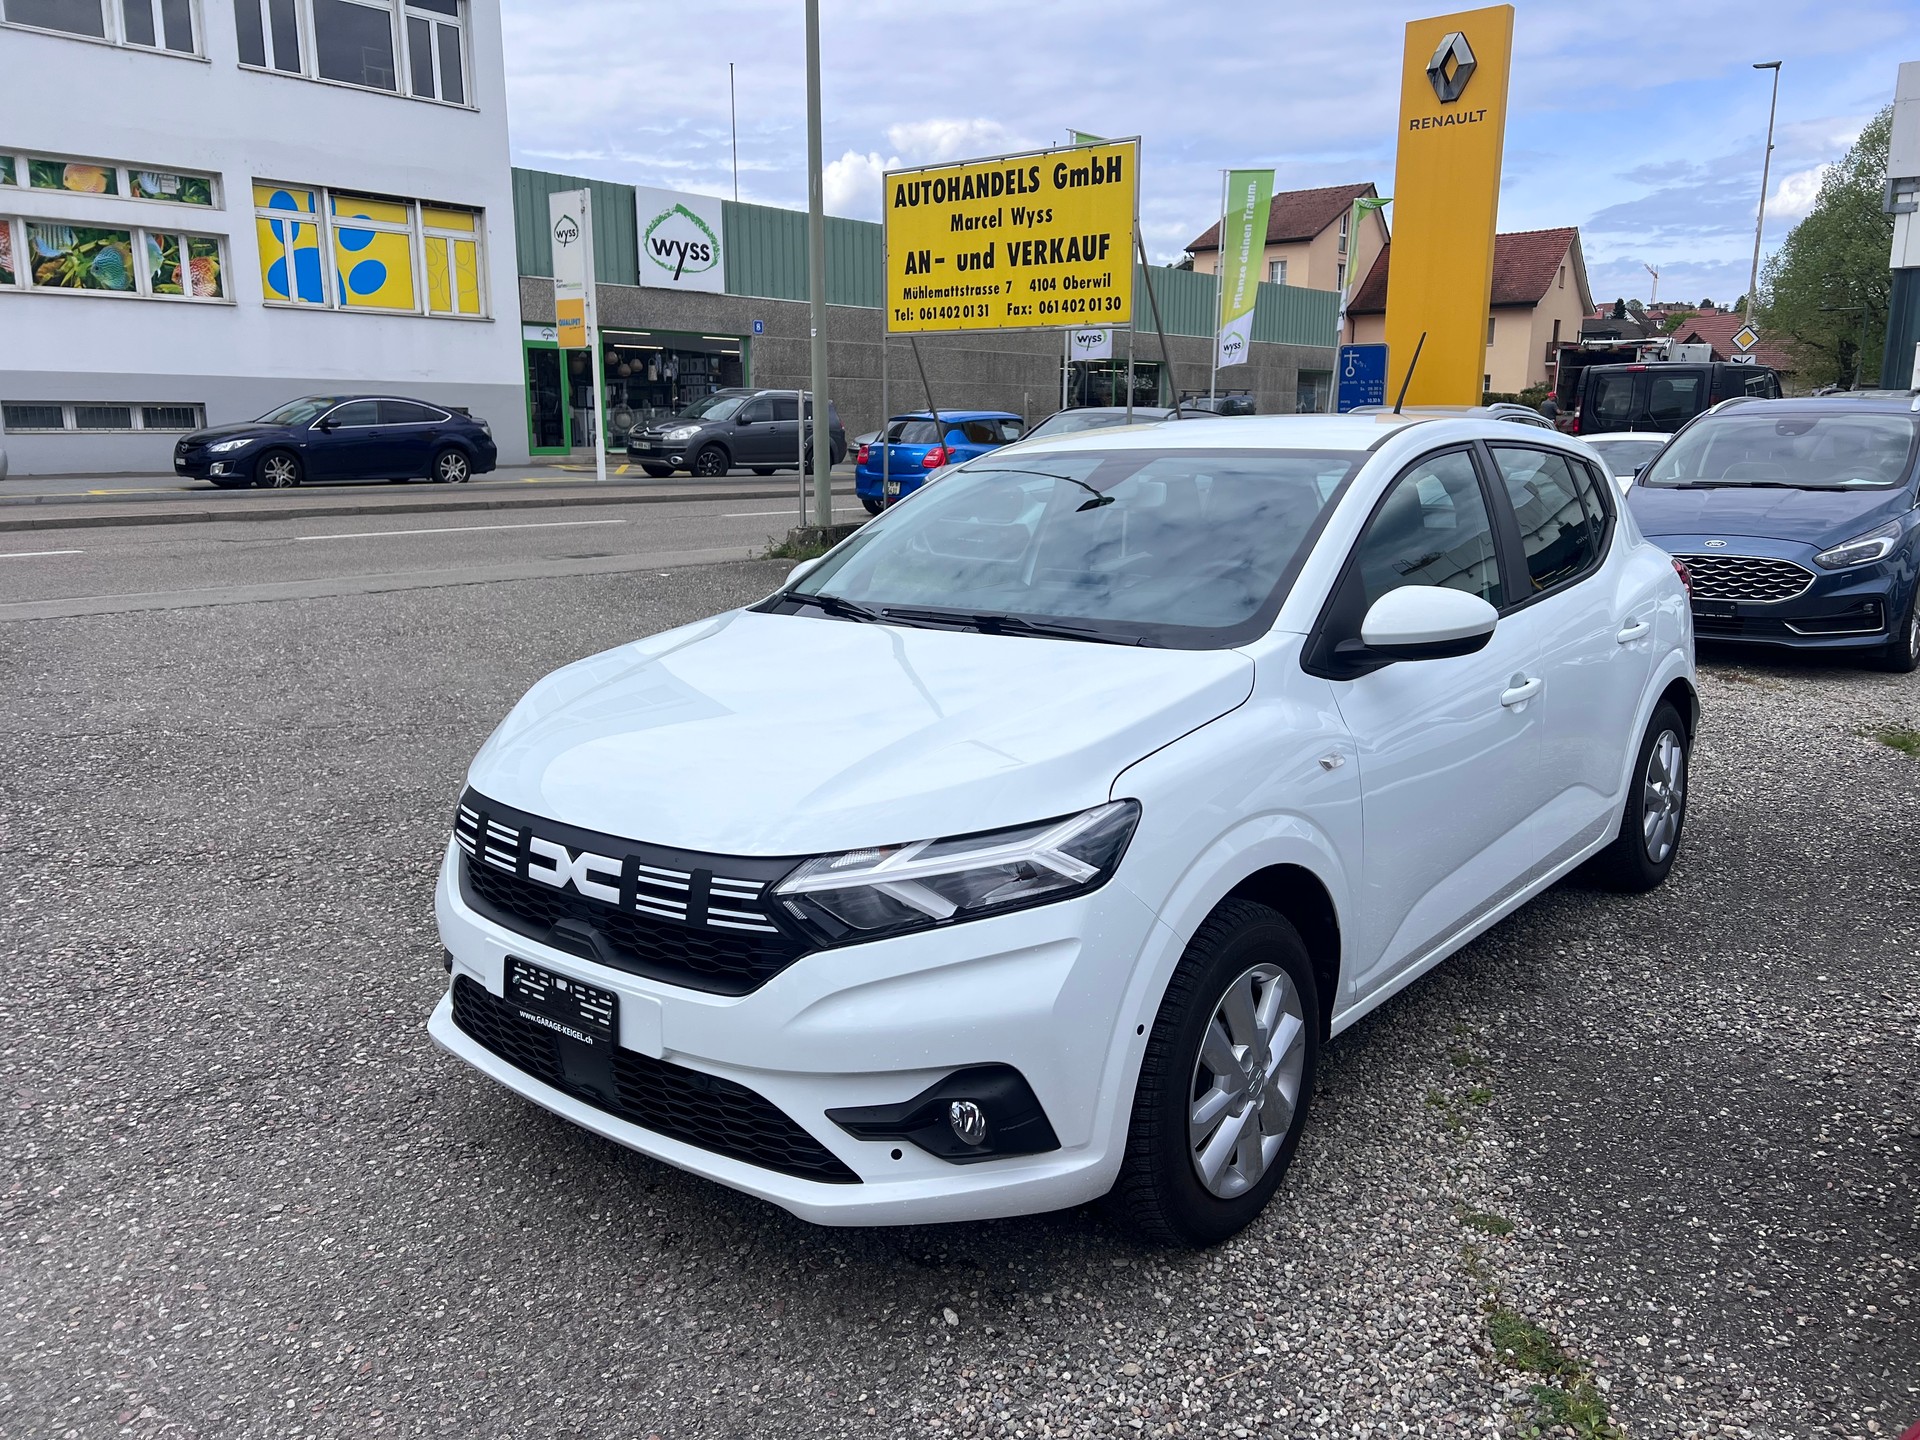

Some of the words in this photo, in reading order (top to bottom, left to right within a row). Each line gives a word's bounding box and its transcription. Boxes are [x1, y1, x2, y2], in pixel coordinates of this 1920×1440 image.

[1409, 109, 1487, 131] RENAULT
[894, 165, 1040, 208] AUTOHANDELS
[1053, 155, 1122, 190] GmbH
[1243, 180, 1257, 221] Traum.
[950, 207, 1003, 232] Marcel
[1010, 206, 1053, 229] Wyss
[556, 228, 576, 248] wyss
[956, 241, 995, 271] und
[1006, 233, 1110, 267] VERKAUF
[1239, 223, 1252, 264] deinen
[651, 237, 710, 281] wyss
[903, 283, 1000, 300] Mühlemattstrasse
[1005, 280, 1012, 294] 7
[1029, 277, 1057, 292] 4104
[1063, 272, 1111, 290] Oberwil
[1233, 265, 1247, 309] Pflanze
[894, 307, 914, 321] Tel:
[1007, 302, 1032, 316] Fax:
[1077, 333, 1102, 352] wyss
[1223, 341, 1242, 359] wyss
[519, 1008, 593, 1045] www.GARAGE-KEIGEL.ch
